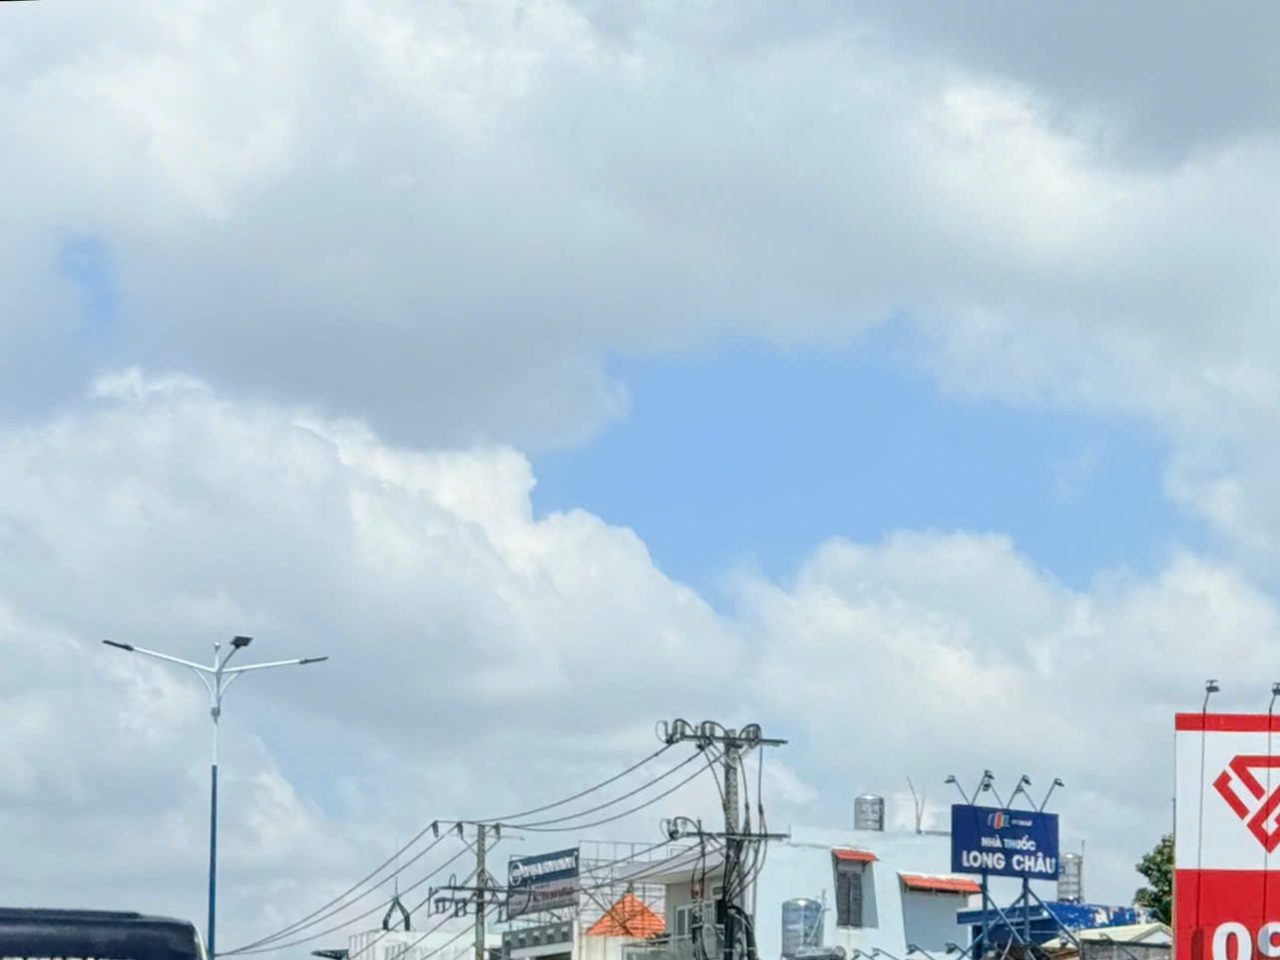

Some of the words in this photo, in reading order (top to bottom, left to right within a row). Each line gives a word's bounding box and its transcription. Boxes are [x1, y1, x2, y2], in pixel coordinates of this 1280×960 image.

[981, 834, 1002, 848] NHÀ
[1003, 834, 1036, 851] THUỐC
[962, 850, 1006, 869] LONG
[1012, 852, 1056, 873] CHÂU
